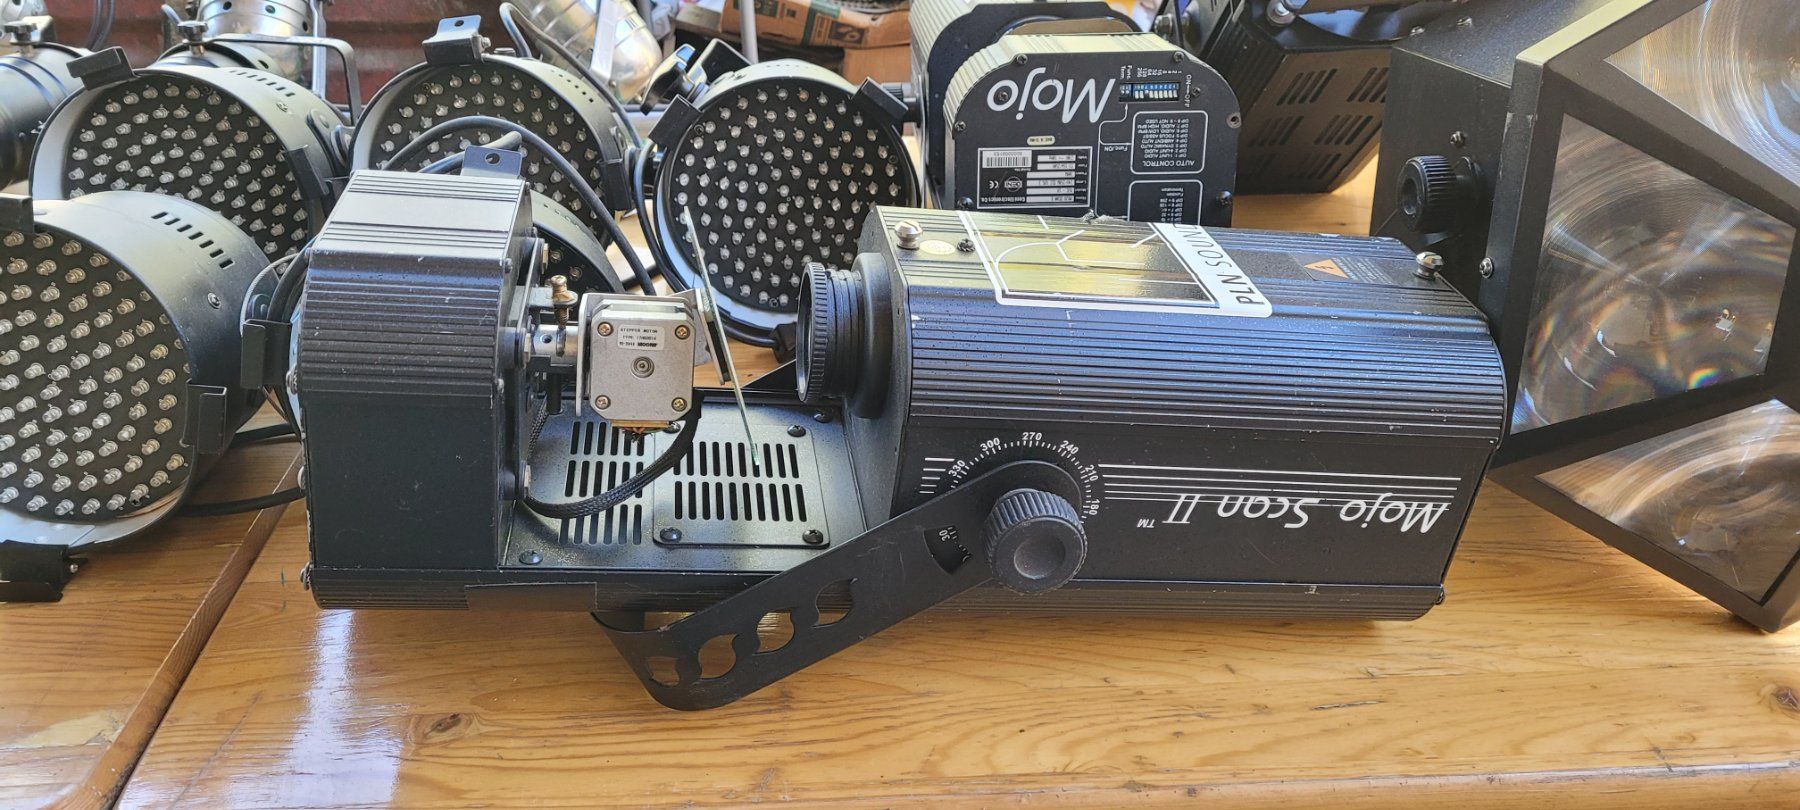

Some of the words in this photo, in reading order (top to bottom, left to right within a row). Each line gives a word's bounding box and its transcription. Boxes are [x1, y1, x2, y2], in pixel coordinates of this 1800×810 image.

[987, 67, 1116, 123] Mojo
[1216, 273, 1263, 304] PLN
[980, 437, 1000, 450] 300
[1022, 432, 1042, 441] 270
[1059, 440, 1079, 454] 240
[948, 459, 965, 477] 330
[1085, 464, 1098, 481] 210
[1089, 498, 1099, 515] 180
[1162, 494, 1201, 524] II
[1217, 495, 1320, 529] Scan
[1340, 493, 1450, 533] Mojo
[938, 529, 951, 541] 30
